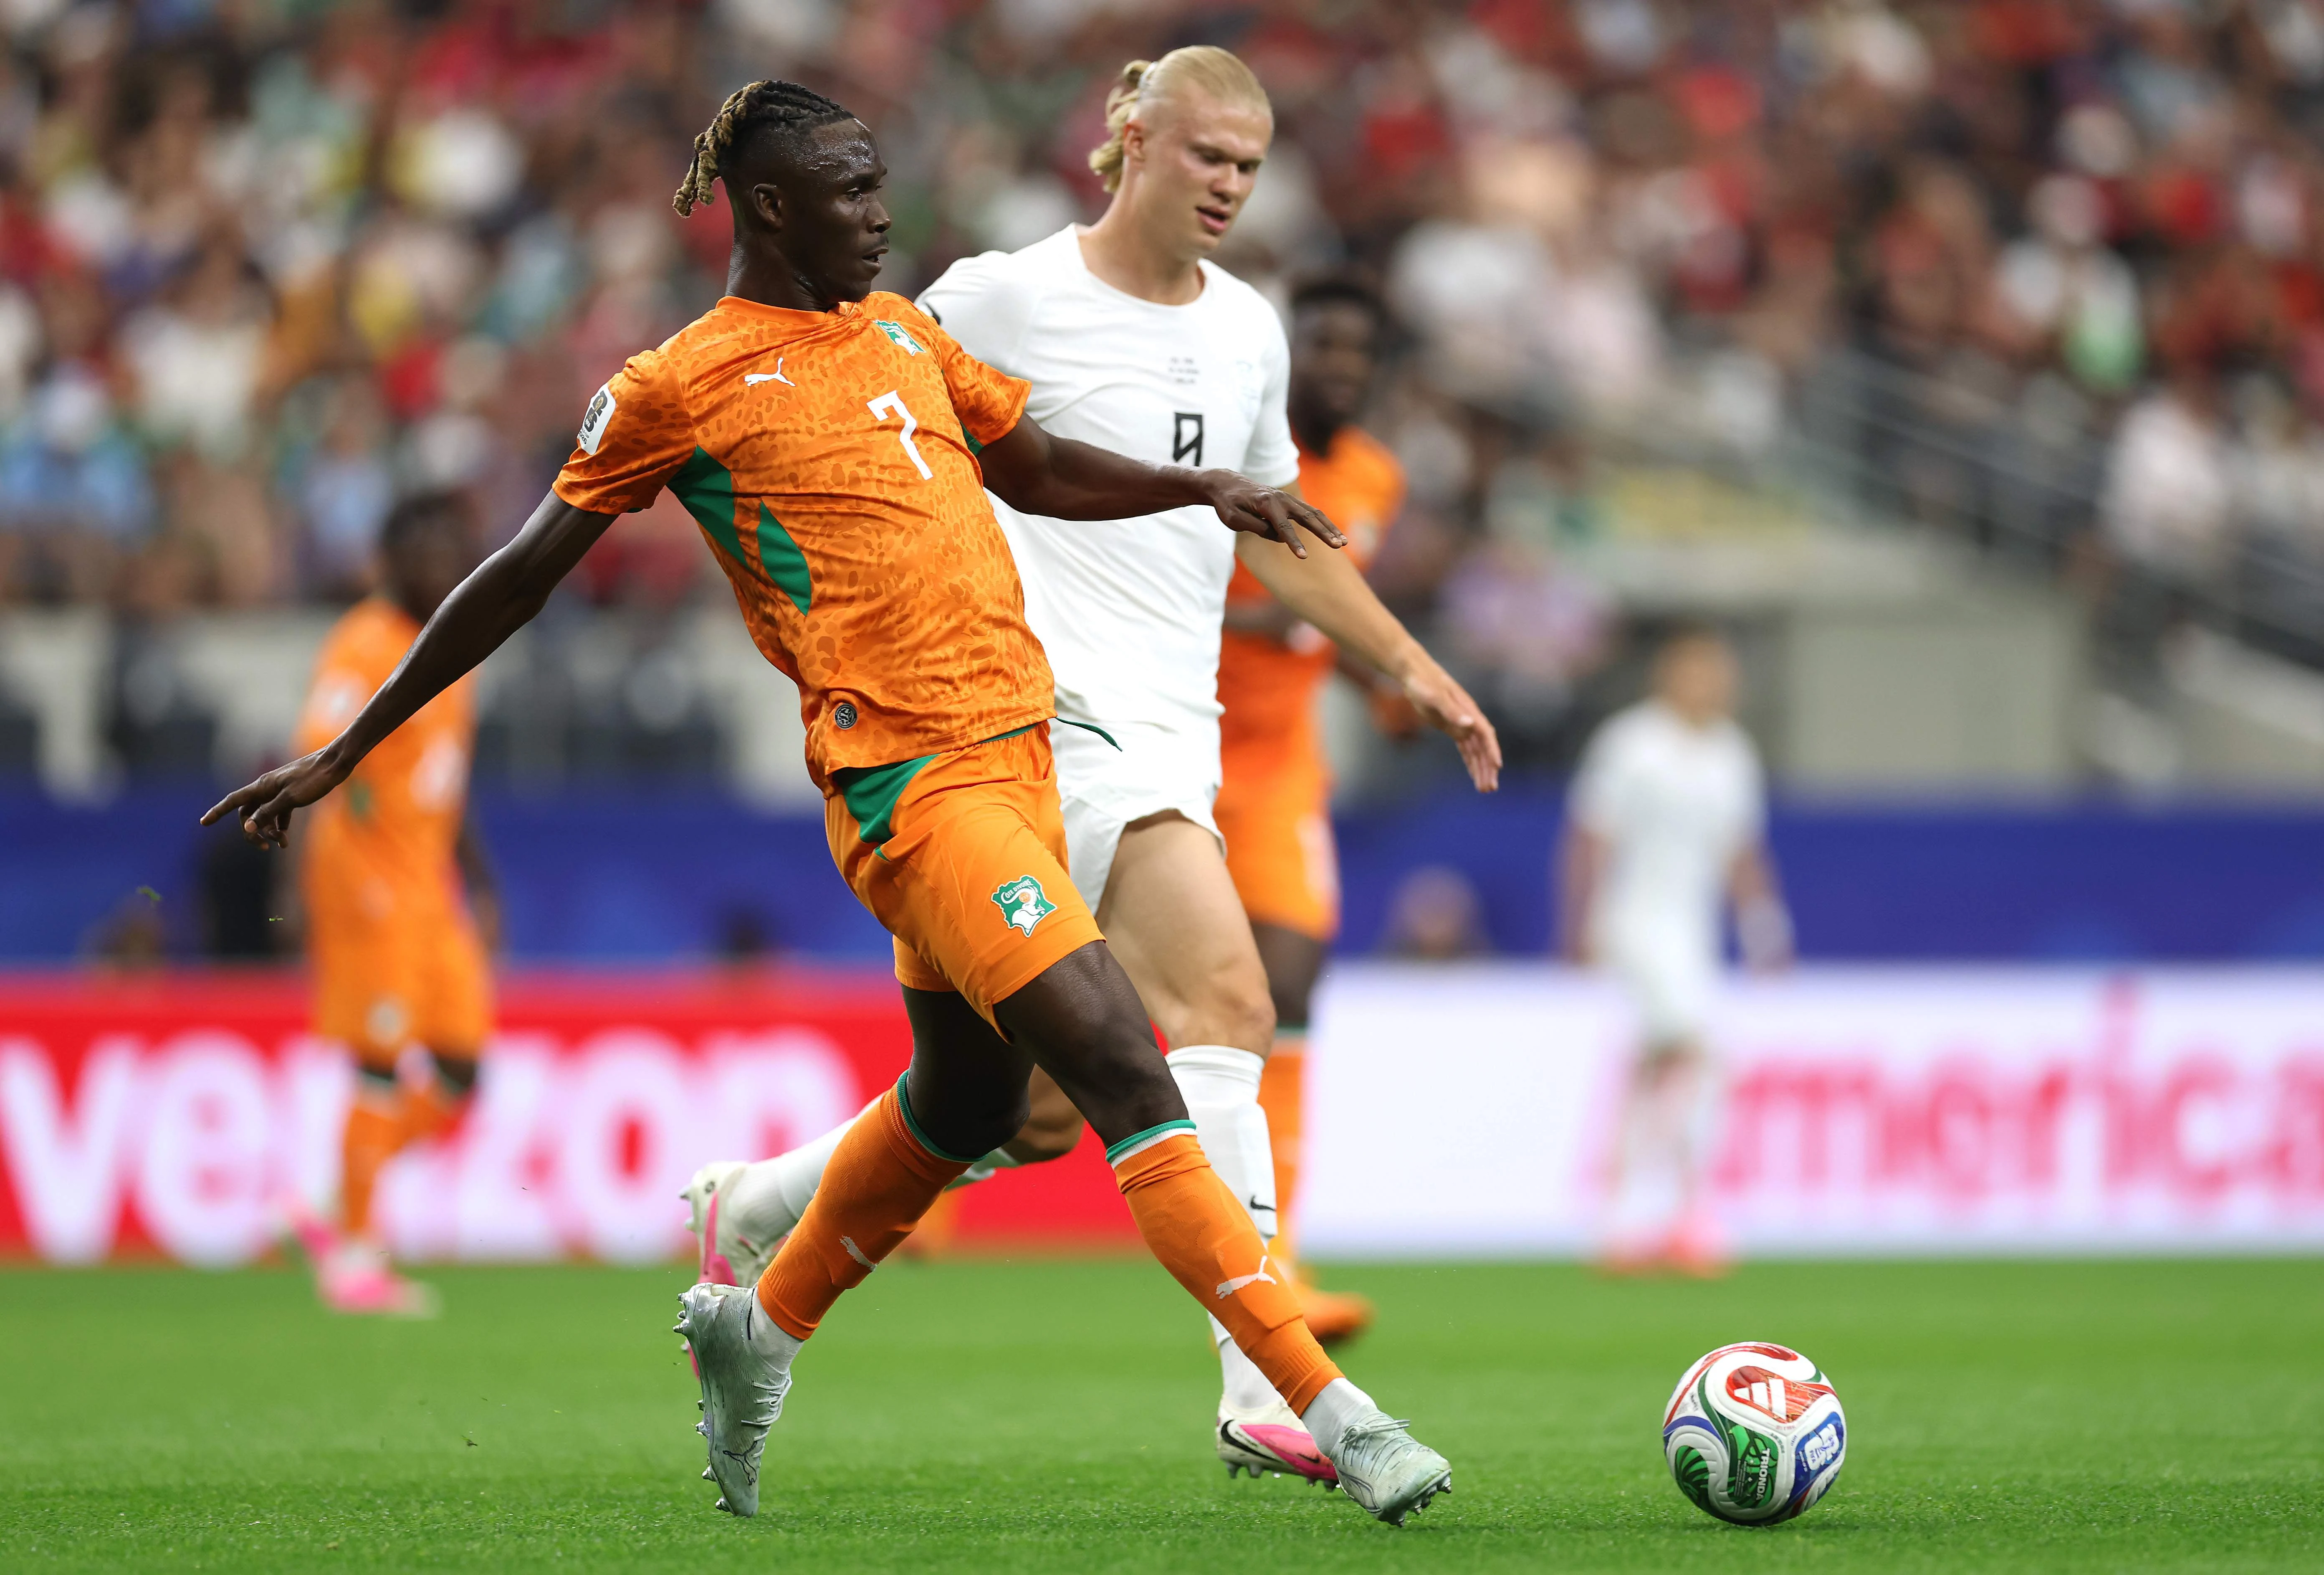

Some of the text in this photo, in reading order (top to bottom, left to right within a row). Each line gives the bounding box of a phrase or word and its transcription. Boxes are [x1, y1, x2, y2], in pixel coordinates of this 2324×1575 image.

[866, 390, 934, 480] 7
[1173, 411, 1203, 467] 9
[0, 1029, 862, 1263] verzon
[1756, 1448, 1770, 1500] TRIONDA
